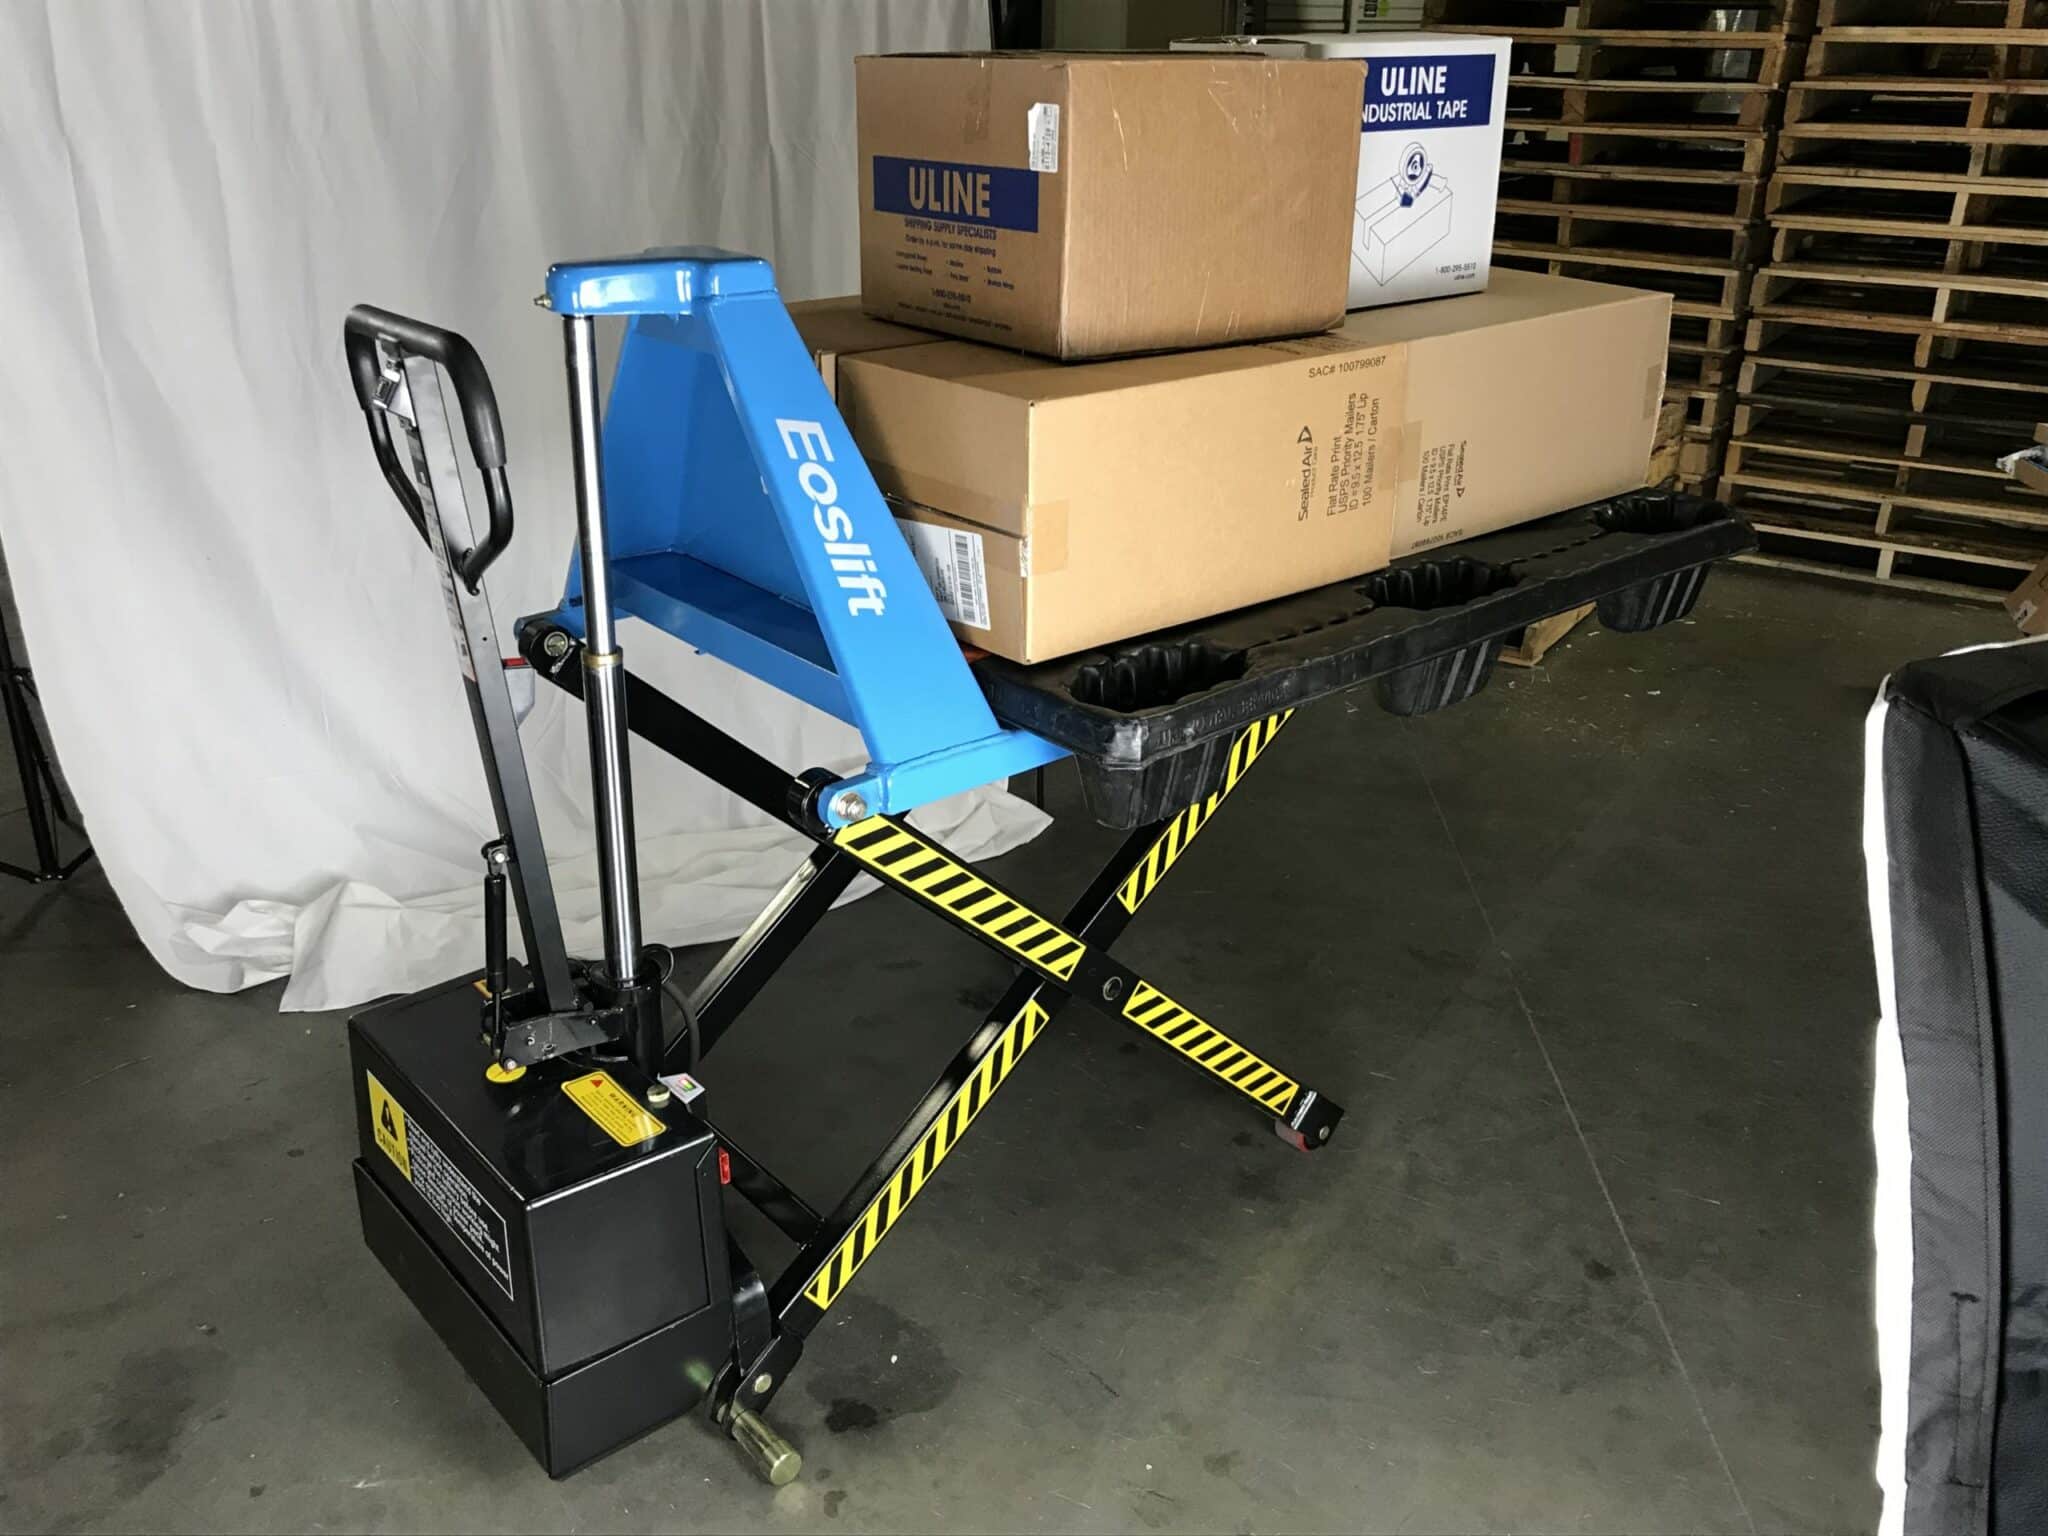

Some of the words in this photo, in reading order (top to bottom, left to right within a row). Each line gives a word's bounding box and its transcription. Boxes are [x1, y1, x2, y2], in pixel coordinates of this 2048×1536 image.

[1381, 65, 1448, 96] ULINE
[1361, 101, 1433, 123] NDUSTRIAL
[1437, 99, 1469, 119] TAPE
[908, 166, 992, 219] ULINE
[934, 221, 956, 234] SUPPLY
[957, 224, 998, 240] SPECIALISTS
[1308, 365, 1336, 379] SAC#
[1339, 356, 1387, 374] 100799087
[1344, 392, 1357, 435] Mailers
[1367, 397, 1379, 436] Carton
[1301, 445, 1313, 467] Air
[1330, 436, 1342, 463] Print
[1341, 437, 1355, 476] Priority
[1364, 445, 1376, 484] Mailers
[1328, 465, 1340, 492] Rate
[1297, 469, 1312, 522] Sealed
[1326, 495, 1338, 517] Flat
[1338, 479, 1350, 513] USPS
[1349, 499, 1359, 511] ID
[1361, 487, 1372, 507] 100
[776, 418, 888, 617] Eoslift
[377, 1128, 409, 1174] CAUTION
